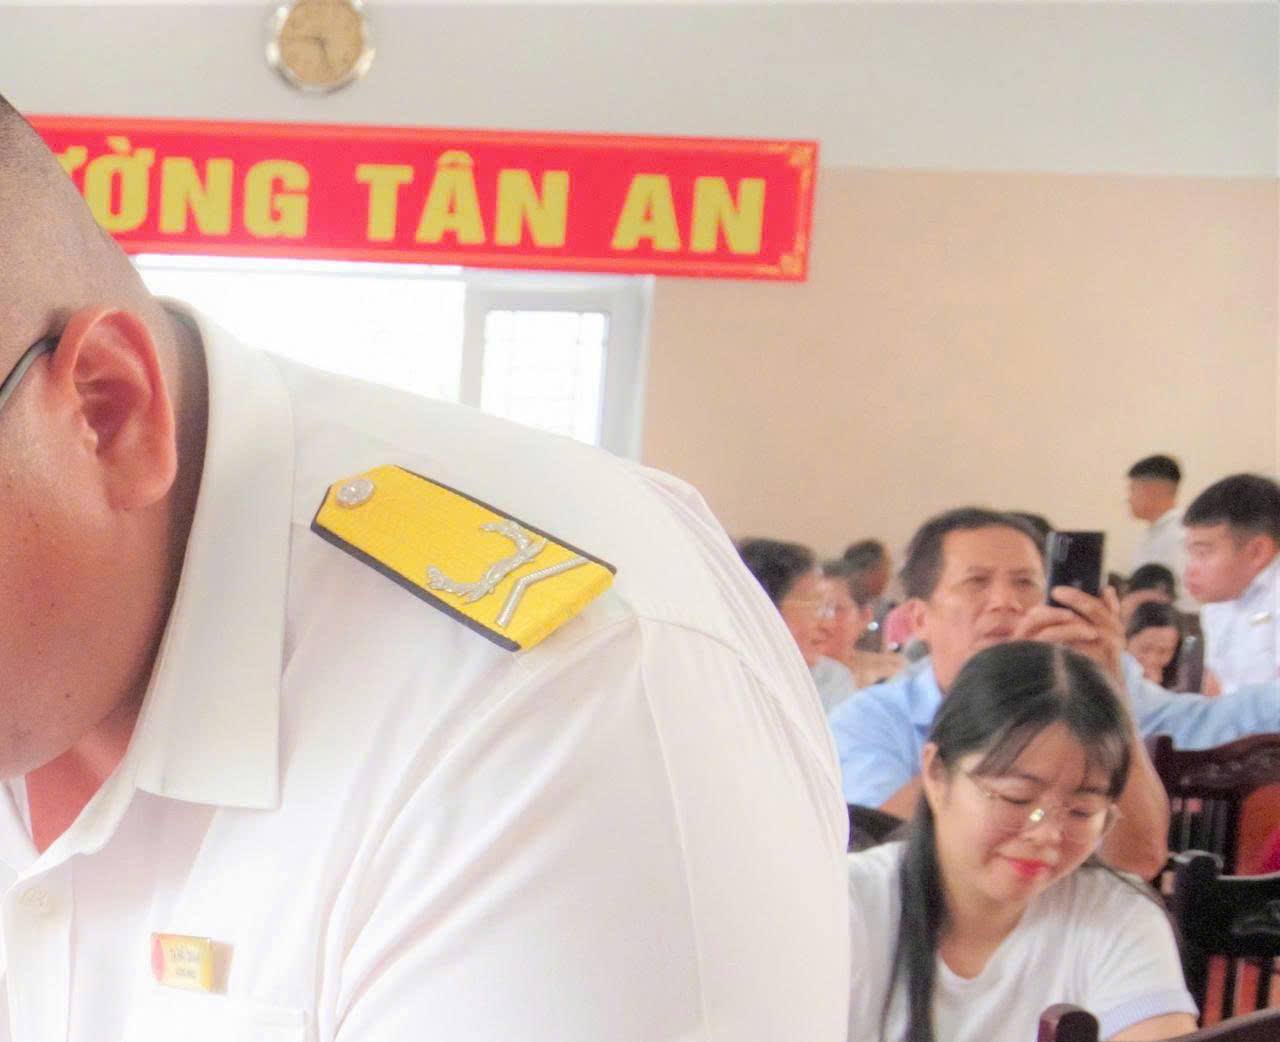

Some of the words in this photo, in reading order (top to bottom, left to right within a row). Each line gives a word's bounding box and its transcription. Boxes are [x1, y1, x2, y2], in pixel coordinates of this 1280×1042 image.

[56, 135, 310, 240] ỜNG
[356, 150, 570, 247] TÂN
[612, 173, 765, 255] AN
